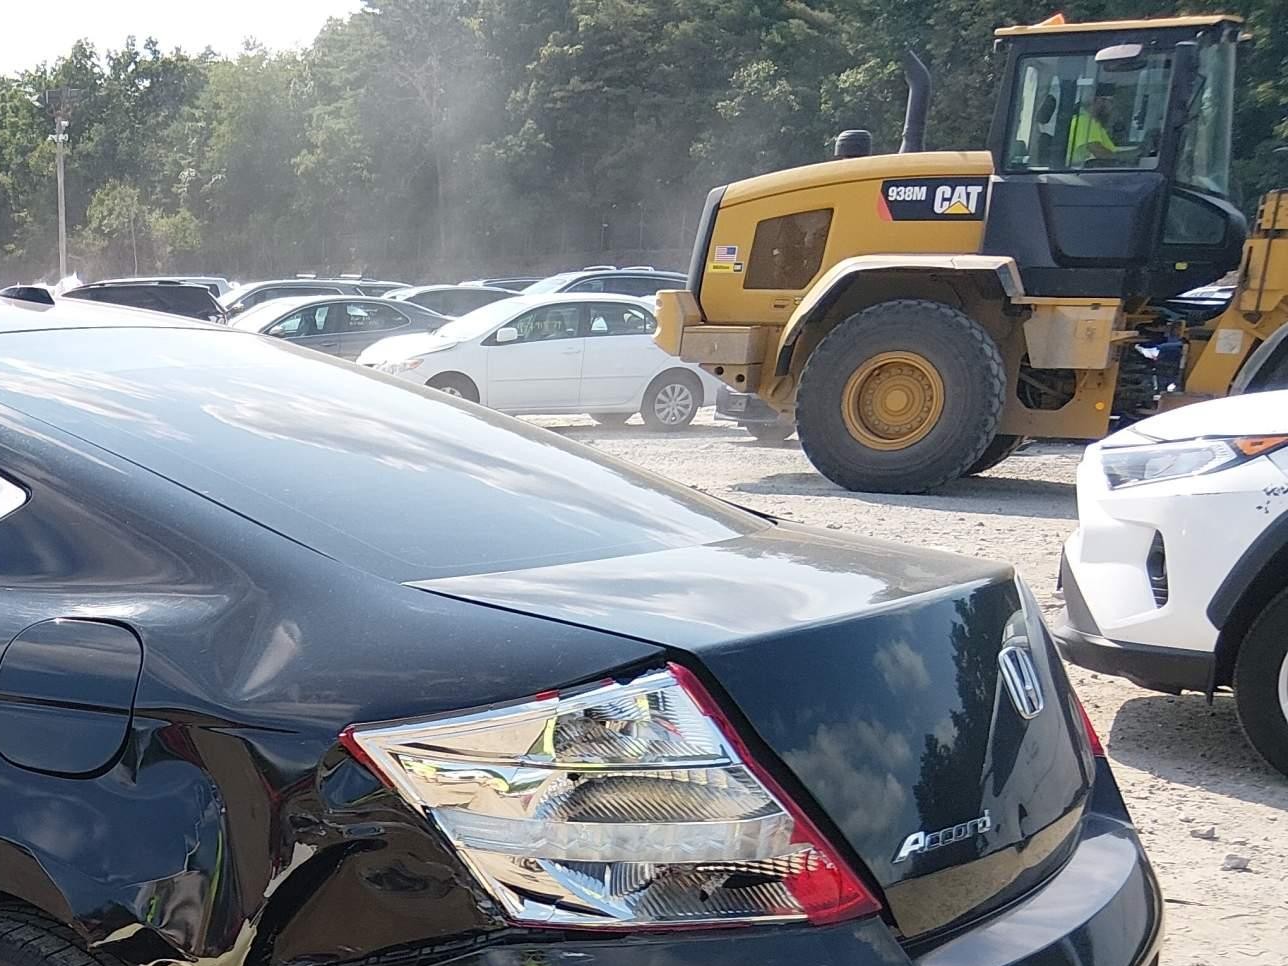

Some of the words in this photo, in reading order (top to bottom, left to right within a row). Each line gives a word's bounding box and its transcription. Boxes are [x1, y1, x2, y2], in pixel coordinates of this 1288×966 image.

[887, 186, 927, 201] 938M
[933, 185, 983, 214] CAT
[892, 809, 991, 864] Accord
